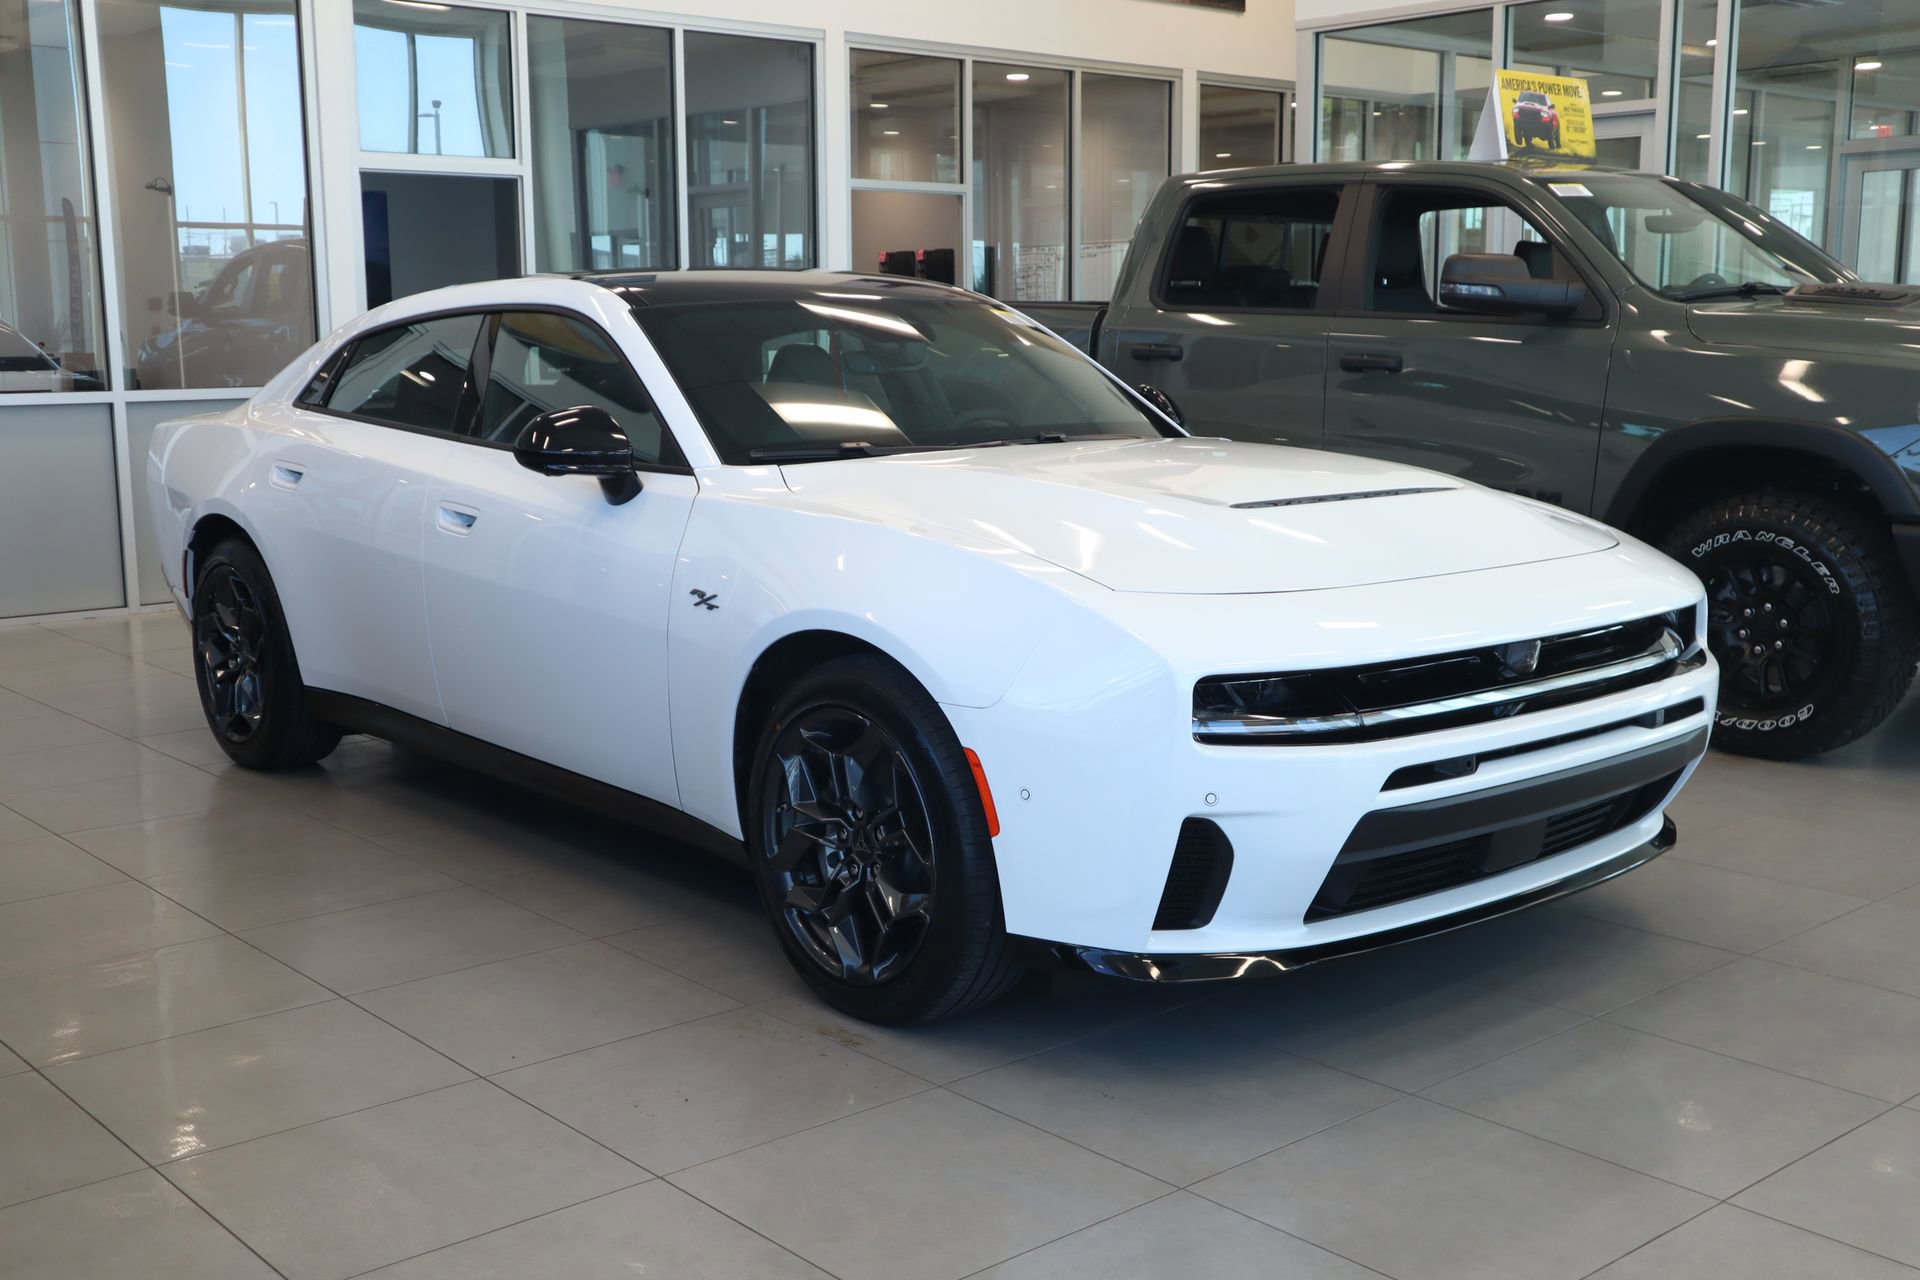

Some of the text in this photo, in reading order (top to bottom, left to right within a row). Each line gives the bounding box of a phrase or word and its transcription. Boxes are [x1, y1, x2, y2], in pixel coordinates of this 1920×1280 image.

[1501, 77, 1537, 92] AMERICA'S
[1538, 82, 1562, 97] POWER
[1692, 530, 1840, 594] WRANGLER
[1714, 703, 1814, 731] GOODY
